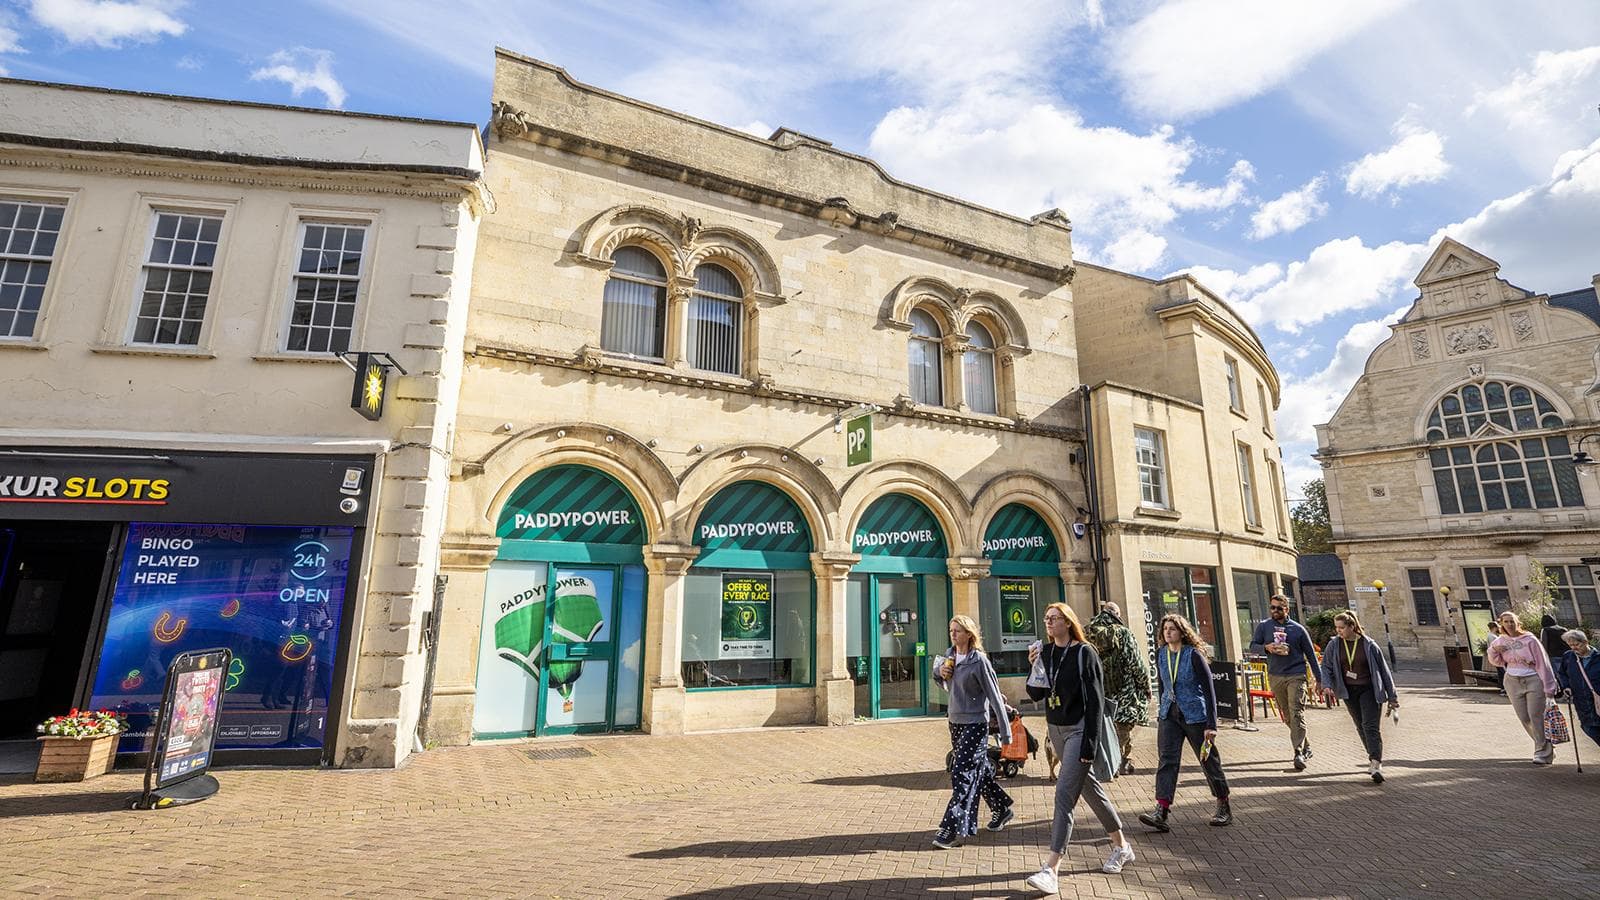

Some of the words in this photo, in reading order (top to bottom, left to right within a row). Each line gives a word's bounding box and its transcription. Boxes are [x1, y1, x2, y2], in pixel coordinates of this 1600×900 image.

[63, 477, 170, 500] SLOTS
[141, 538, 194, 550] BINGO
[137, 555, 200, 567] PLAYED
[294, 553, 326, 567] 24h
[133, 572, 178, 584] HERE
[727, 583, 752, 591] OFFER
[754, 583, 767, 591] ON
[280, 588, 330, 603] OPEN
[723, 592, 750, 600] EVERY
[751, 592, 770, 600] RACE
